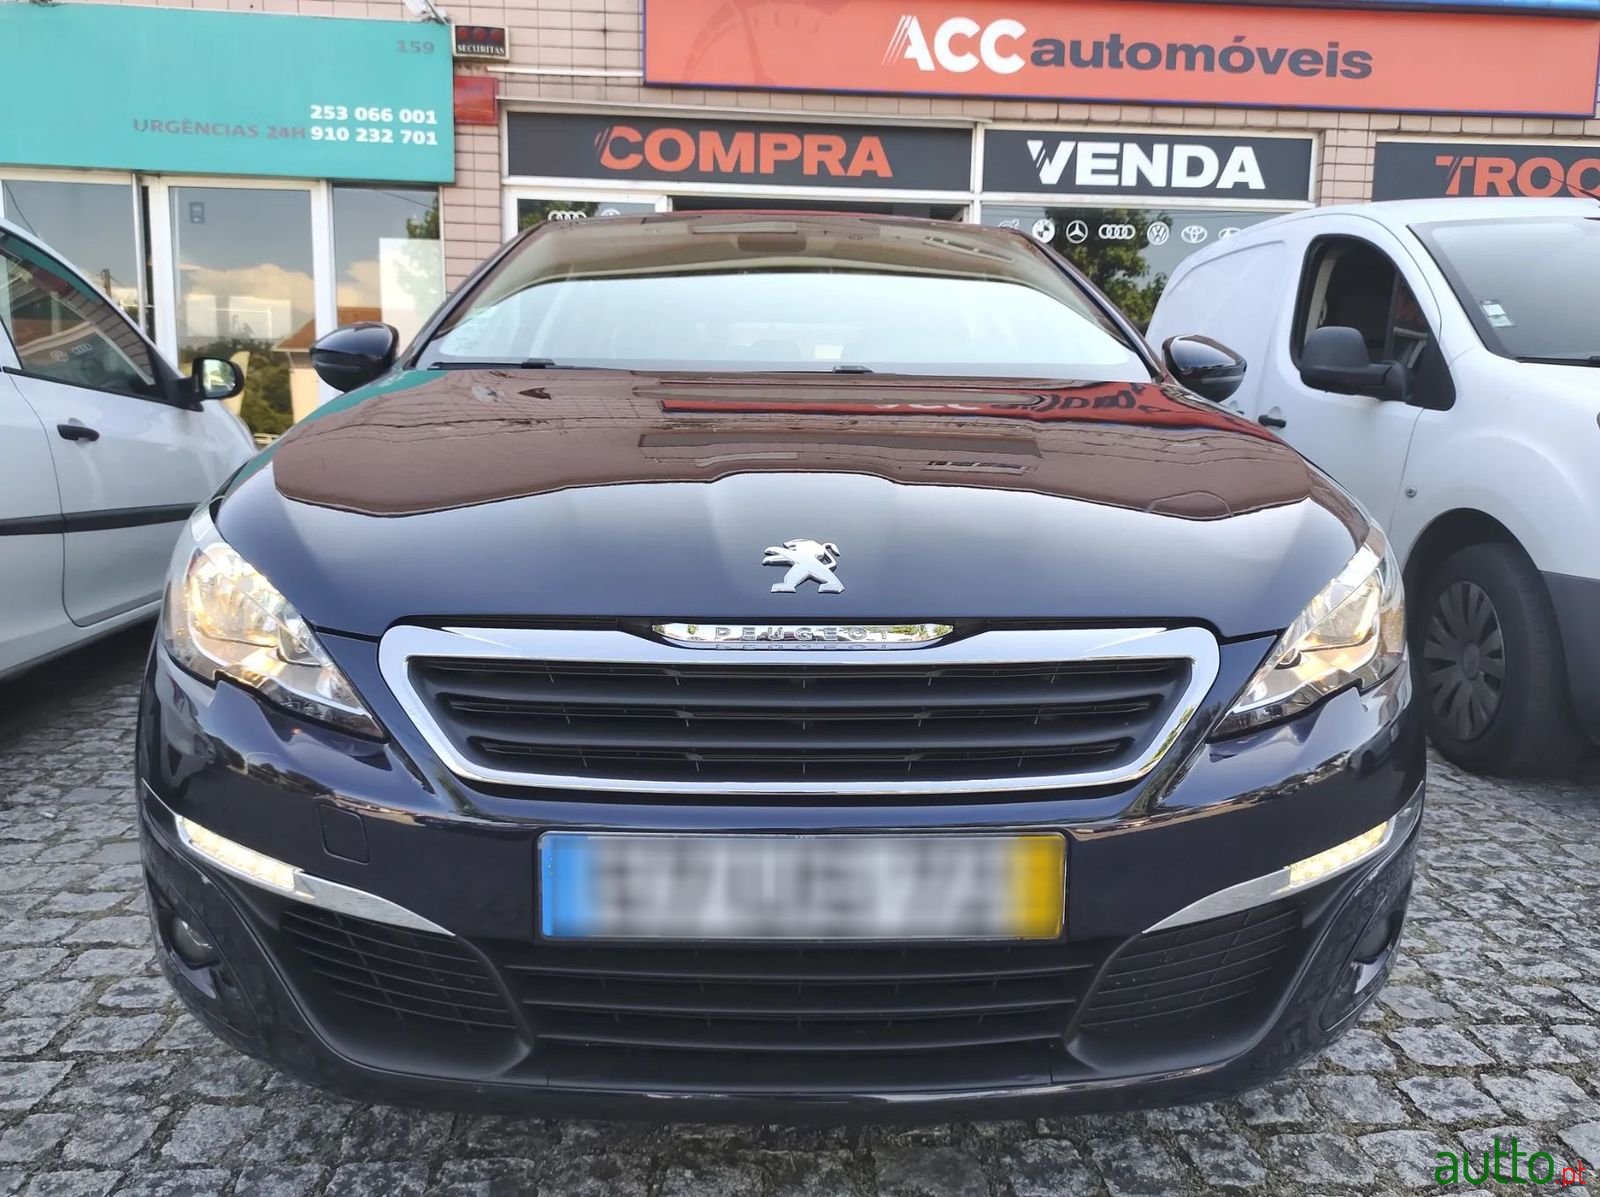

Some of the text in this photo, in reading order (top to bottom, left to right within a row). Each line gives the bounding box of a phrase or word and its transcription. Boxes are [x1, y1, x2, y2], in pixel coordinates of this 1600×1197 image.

[396, 39, 434, 55] 159
[457, 43, 505, 55] SECURITAS
[884, 15, 1373, 80] ACC automóveis
[310, 104, 438, 125] 253 066 001
[133, 116, 438, 146] URGÊNCIAS 24H 910 232 701
[594, 125, 893, 178] COMPRA
[1027, 139, 1266, 191] VENDA
[715, 626, 888, 641] PEUGEOT
